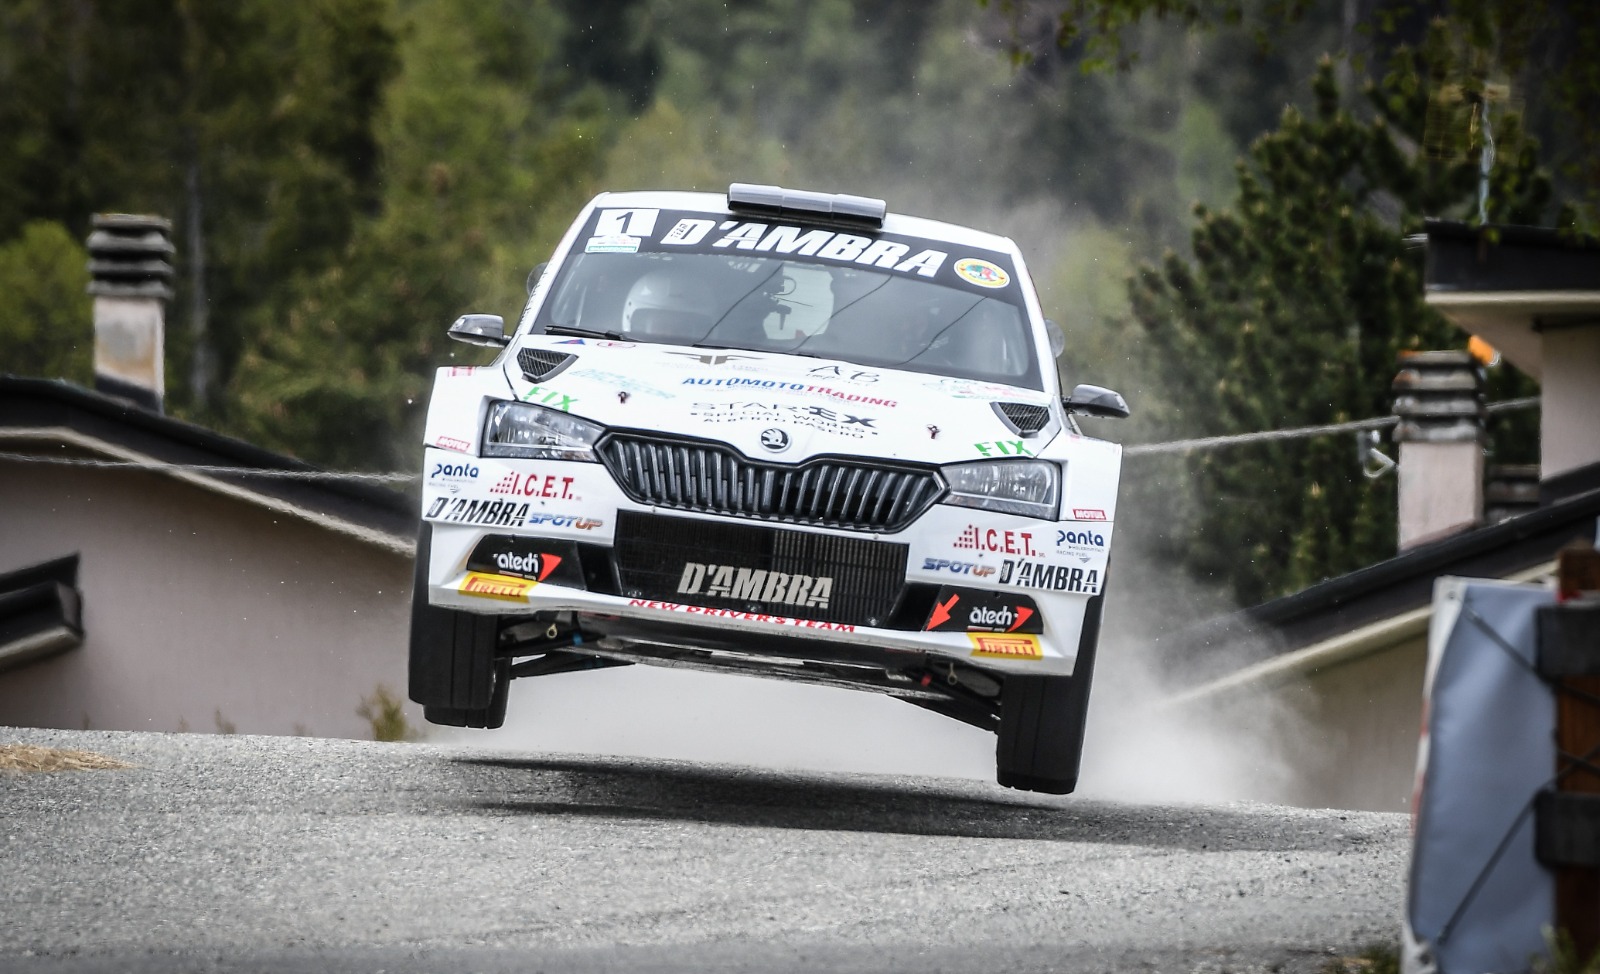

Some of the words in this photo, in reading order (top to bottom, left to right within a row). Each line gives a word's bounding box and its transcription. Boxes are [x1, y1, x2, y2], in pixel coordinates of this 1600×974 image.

[616, 211, 634, 234] 1
[660, 218, 948, 278] D'AMBRA
[523, 386, 579, 413] FIX
[681, 377, 898, 408] AUTOMOTOTRADING
[703, 410, 782, 418] SPECIAL
[792, 413, 865, 433] WORKS
[974, 439, 1035, 458] FIX
[431, 463, 480, 478] panta
[425, 496, 530, 527] D'AMBRA
[1075, 509, 1105, 520] MOTUL
[1056, 529, 1105, 547] panta
[465, 576, 527, 598] PIRELLI
[677, 562, 834, 609] D'AMBRA
[998, 558, 1098, 594] D'AMBRA
[628, 599, 680, 612] NEW
[793, 618, 856, 634] TEAM
[976, 637, 1034, 657] PIRELLI
